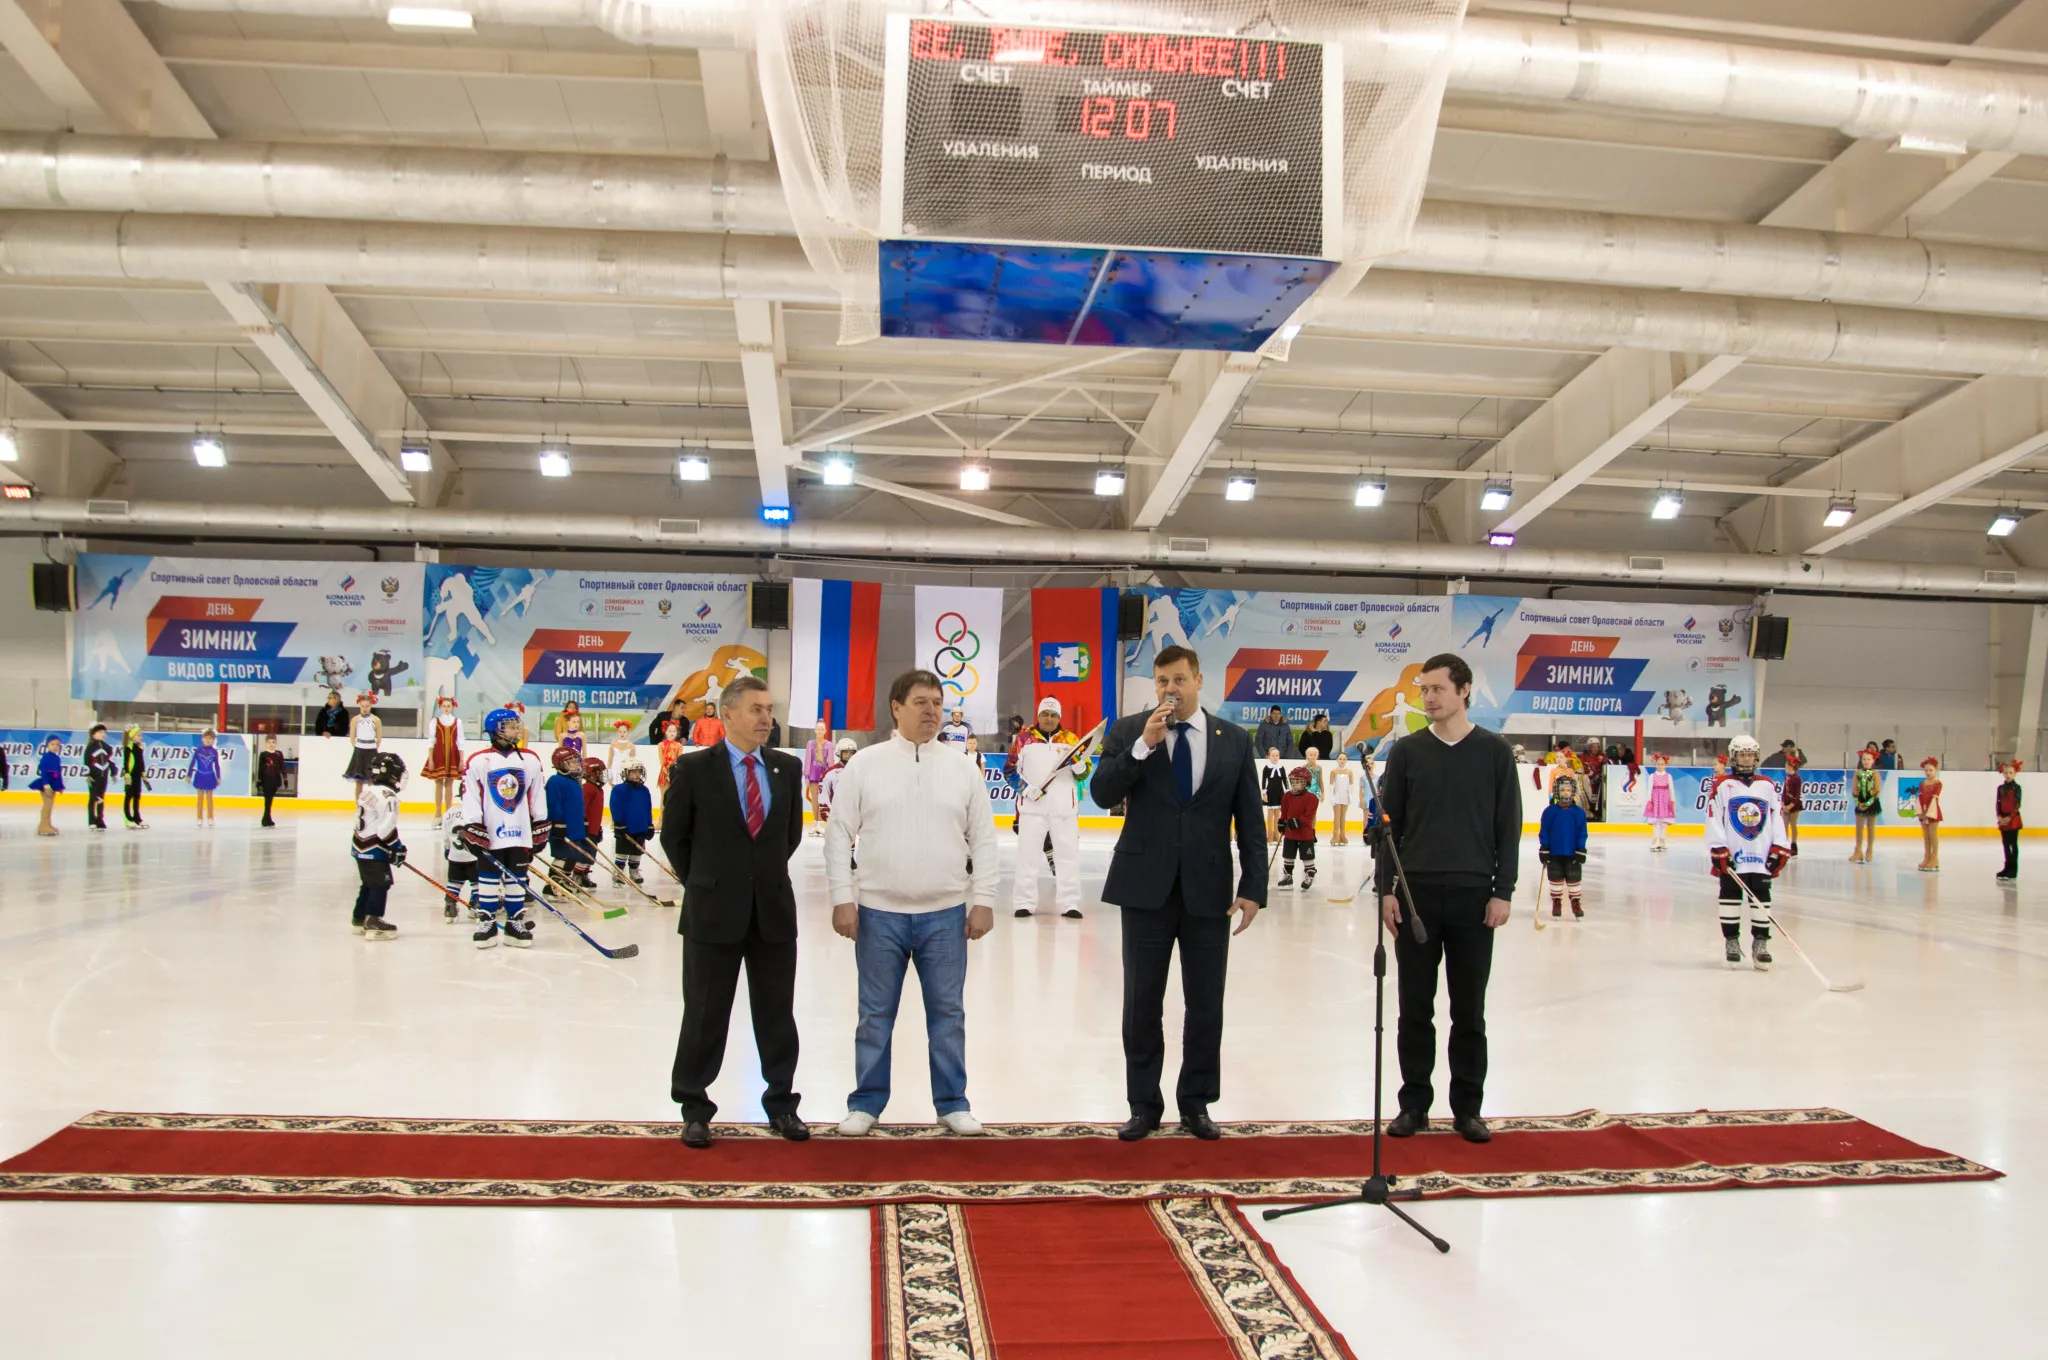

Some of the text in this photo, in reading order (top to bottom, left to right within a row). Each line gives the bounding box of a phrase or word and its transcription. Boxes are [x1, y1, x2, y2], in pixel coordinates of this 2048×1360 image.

[1103, 32, 1286, 80] СИЛЬНЕЕ!!!
[960, 64, 1012, 83] СЧЕТ
[1083, 79, 1152, 98] ТАЙМЕР
[1221, 79, 1273, 100] СЧЕТ
[943, 140, 1039, 159] УДАЛЕНИЯ
[1195, 154, 1289, 173] УДАЛЕНИЯ
[1081, 163, 1152, 184] ПЕРИОД
[150, 571, 318, 588] Спортивный совет Орловской области
[579, 577, 748, 593] Спортивный совет Орловской област
[206, 602, 235, 617] ДЕНЬ
[1280, 599, 1440, 614] Спортивный совет Орловской области
[1520, 611, 1665, 627] Спортивный совет Орловской области
[180, 628, 257, 651] ЗИМНИХ
[577, 635, 604, 648] ДЕНЬ
[1569, 640, 1595, 653] ДЕНЬ
[555, 658, 627, 680] ЗИМНИХ
[1278, 654, 1303, 666] ДЕНЬ
[167, 661, 271, 680] ВИДОВ СПОРТА
[1546, 664, 1614, 686] ЗИМНИХ
[1255, 677, 1322, 696] ЗИМНИХ
[543, 689, 638, 705] ВИДОВ СПОРТА
[1532, 695, 1622, 712] ВИДОВ СПОРТА
[1242, 706, 1282, 722] ВИД
